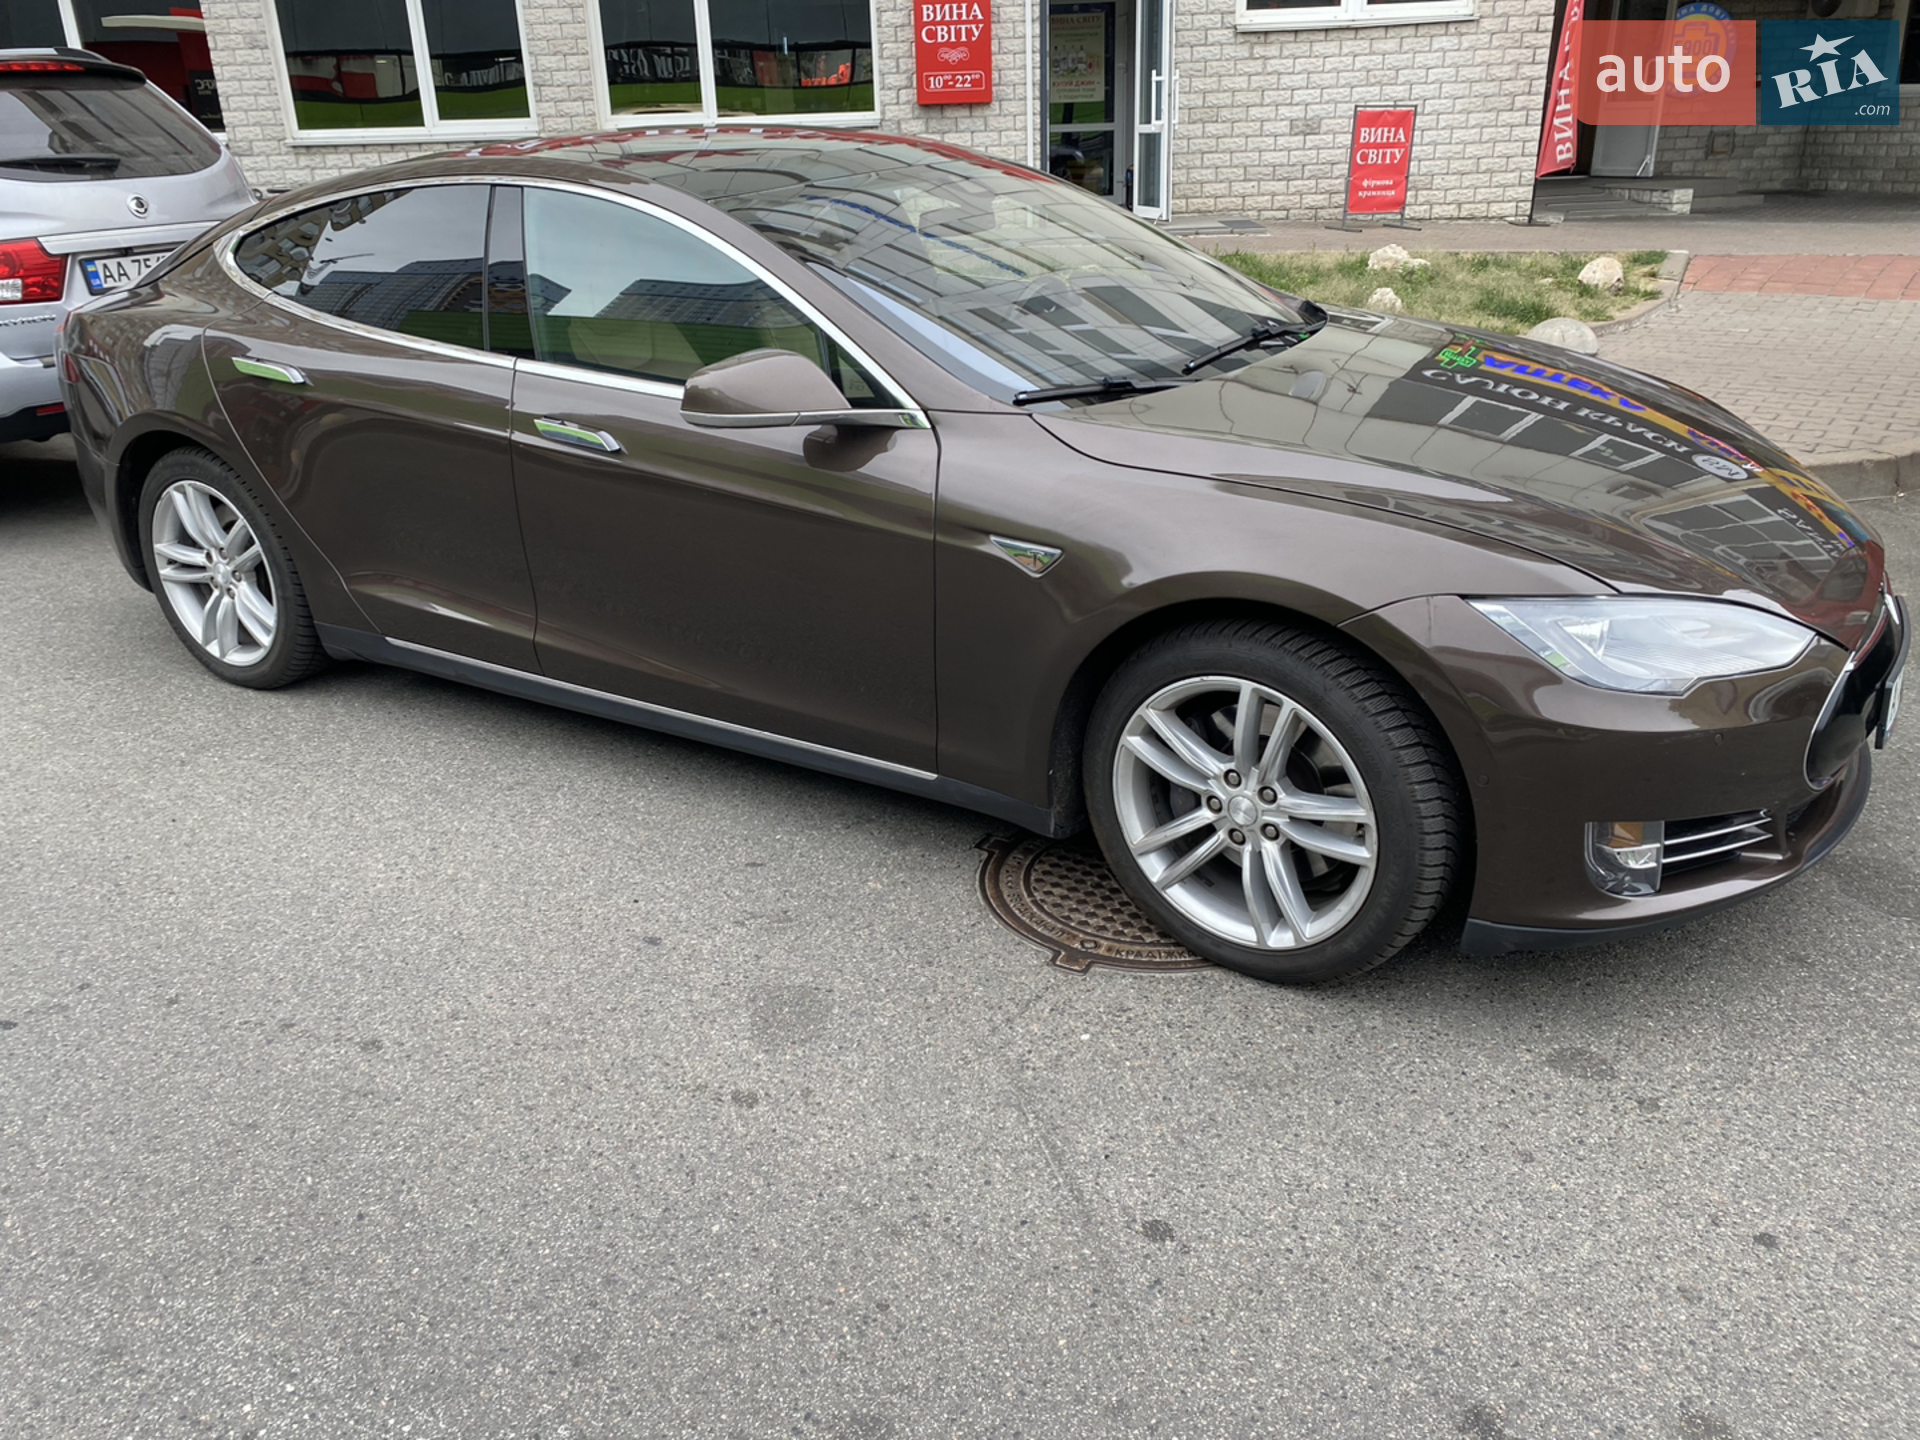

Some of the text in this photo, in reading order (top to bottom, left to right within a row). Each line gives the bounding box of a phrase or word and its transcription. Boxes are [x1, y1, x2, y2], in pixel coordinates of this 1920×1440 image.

[921, 2, 985, 22] ВИНА
[921, 23, 985, 43] СВІТУ
[1552, 57, 1576, 163] ВИНА
[1359, 127, 1406, 143] ВИНА
[1356, 148, 1406, 166] СВІТУ
[1362, 177, 1394, 188] фірмова
[1357, 190, 1396, 199] крамниця
[102, 260, 131, 285] AA
